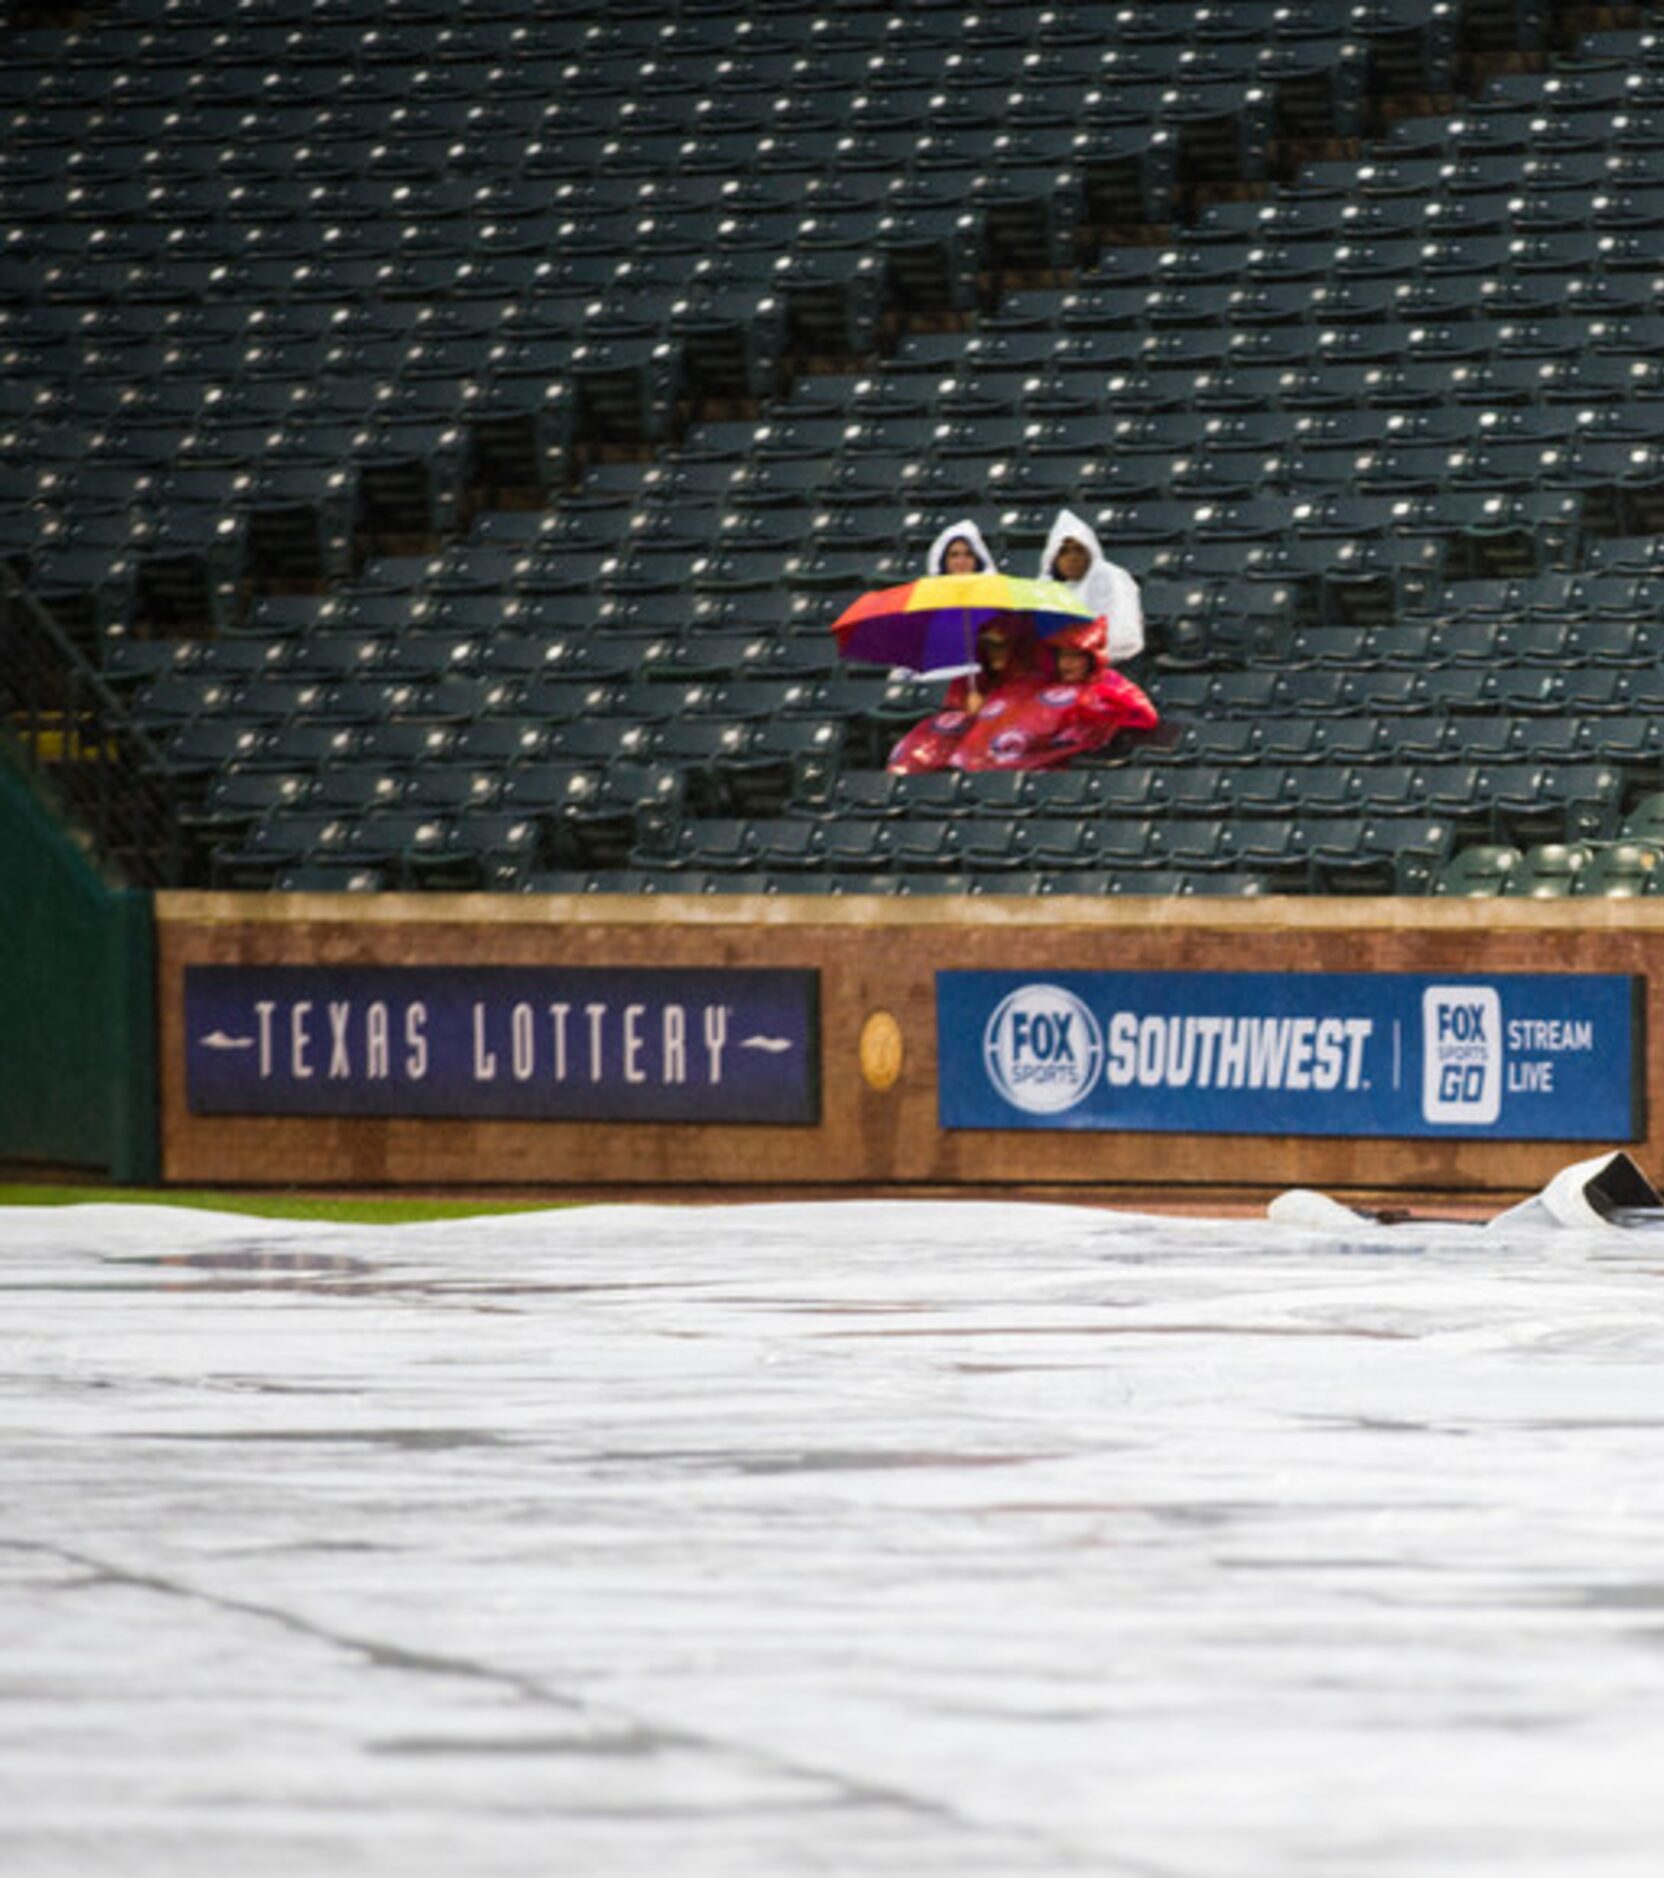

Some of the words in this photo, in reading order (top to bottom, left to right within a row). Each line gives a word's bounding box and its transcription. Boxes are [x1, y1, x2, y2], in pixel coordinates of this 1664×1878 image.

[1012, 1011, 1075, 1062] FOX
[1437, 1004, 1486, 1042] FOX
[1507, 1020, 1593, 1050] STREAM
[255, 1001, 428, 1079] TEXAS
[473, 1002, 727, 1083] LOTTERY
[1437, 1046, 1488, 1061] SPORTS
[1010, 1064, 1080, 1085] SPORTS
[1439, 1065, 1486, 1102] GO
[1508, 1062, 1554, 1092] LIVE
